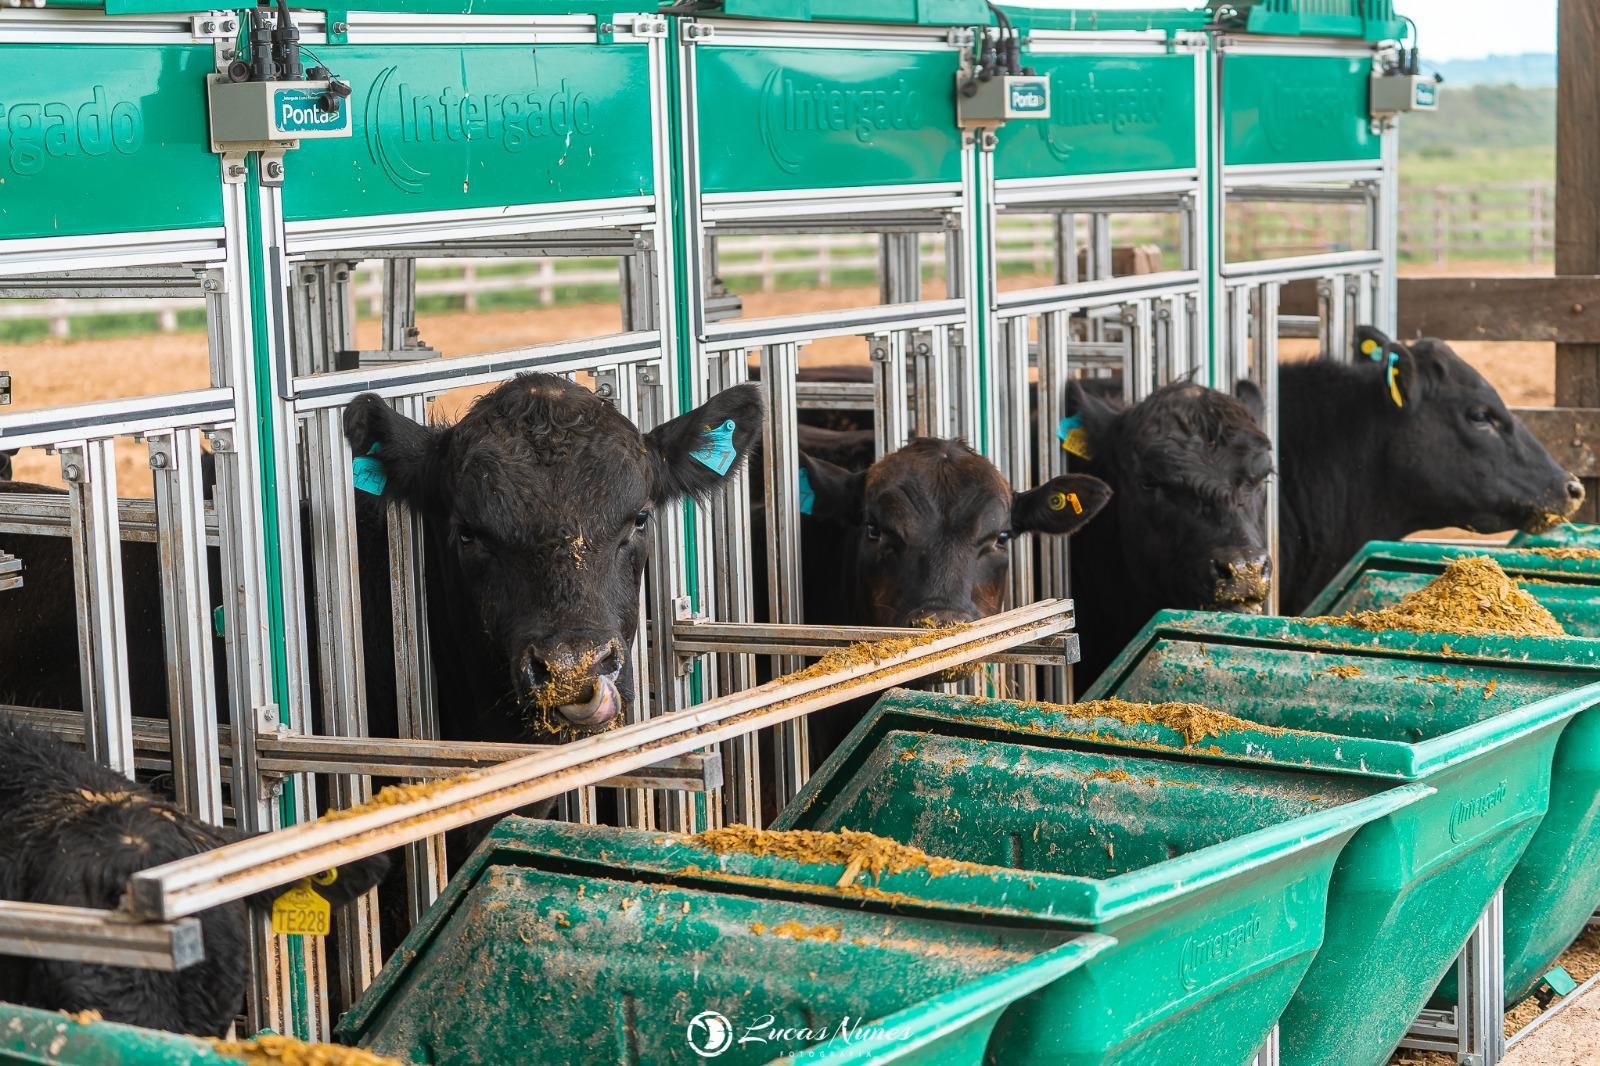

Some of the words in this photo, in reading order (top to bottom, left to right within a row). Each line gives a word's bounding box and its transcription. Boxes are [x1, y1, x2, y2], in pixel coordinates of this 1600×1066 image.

[283, 104, 328, 125] Ponta
[398, 78, 593, 153] Intergado
[784, 78, 921, 143] Intergado
[277, 909, 325, 932] TE228
